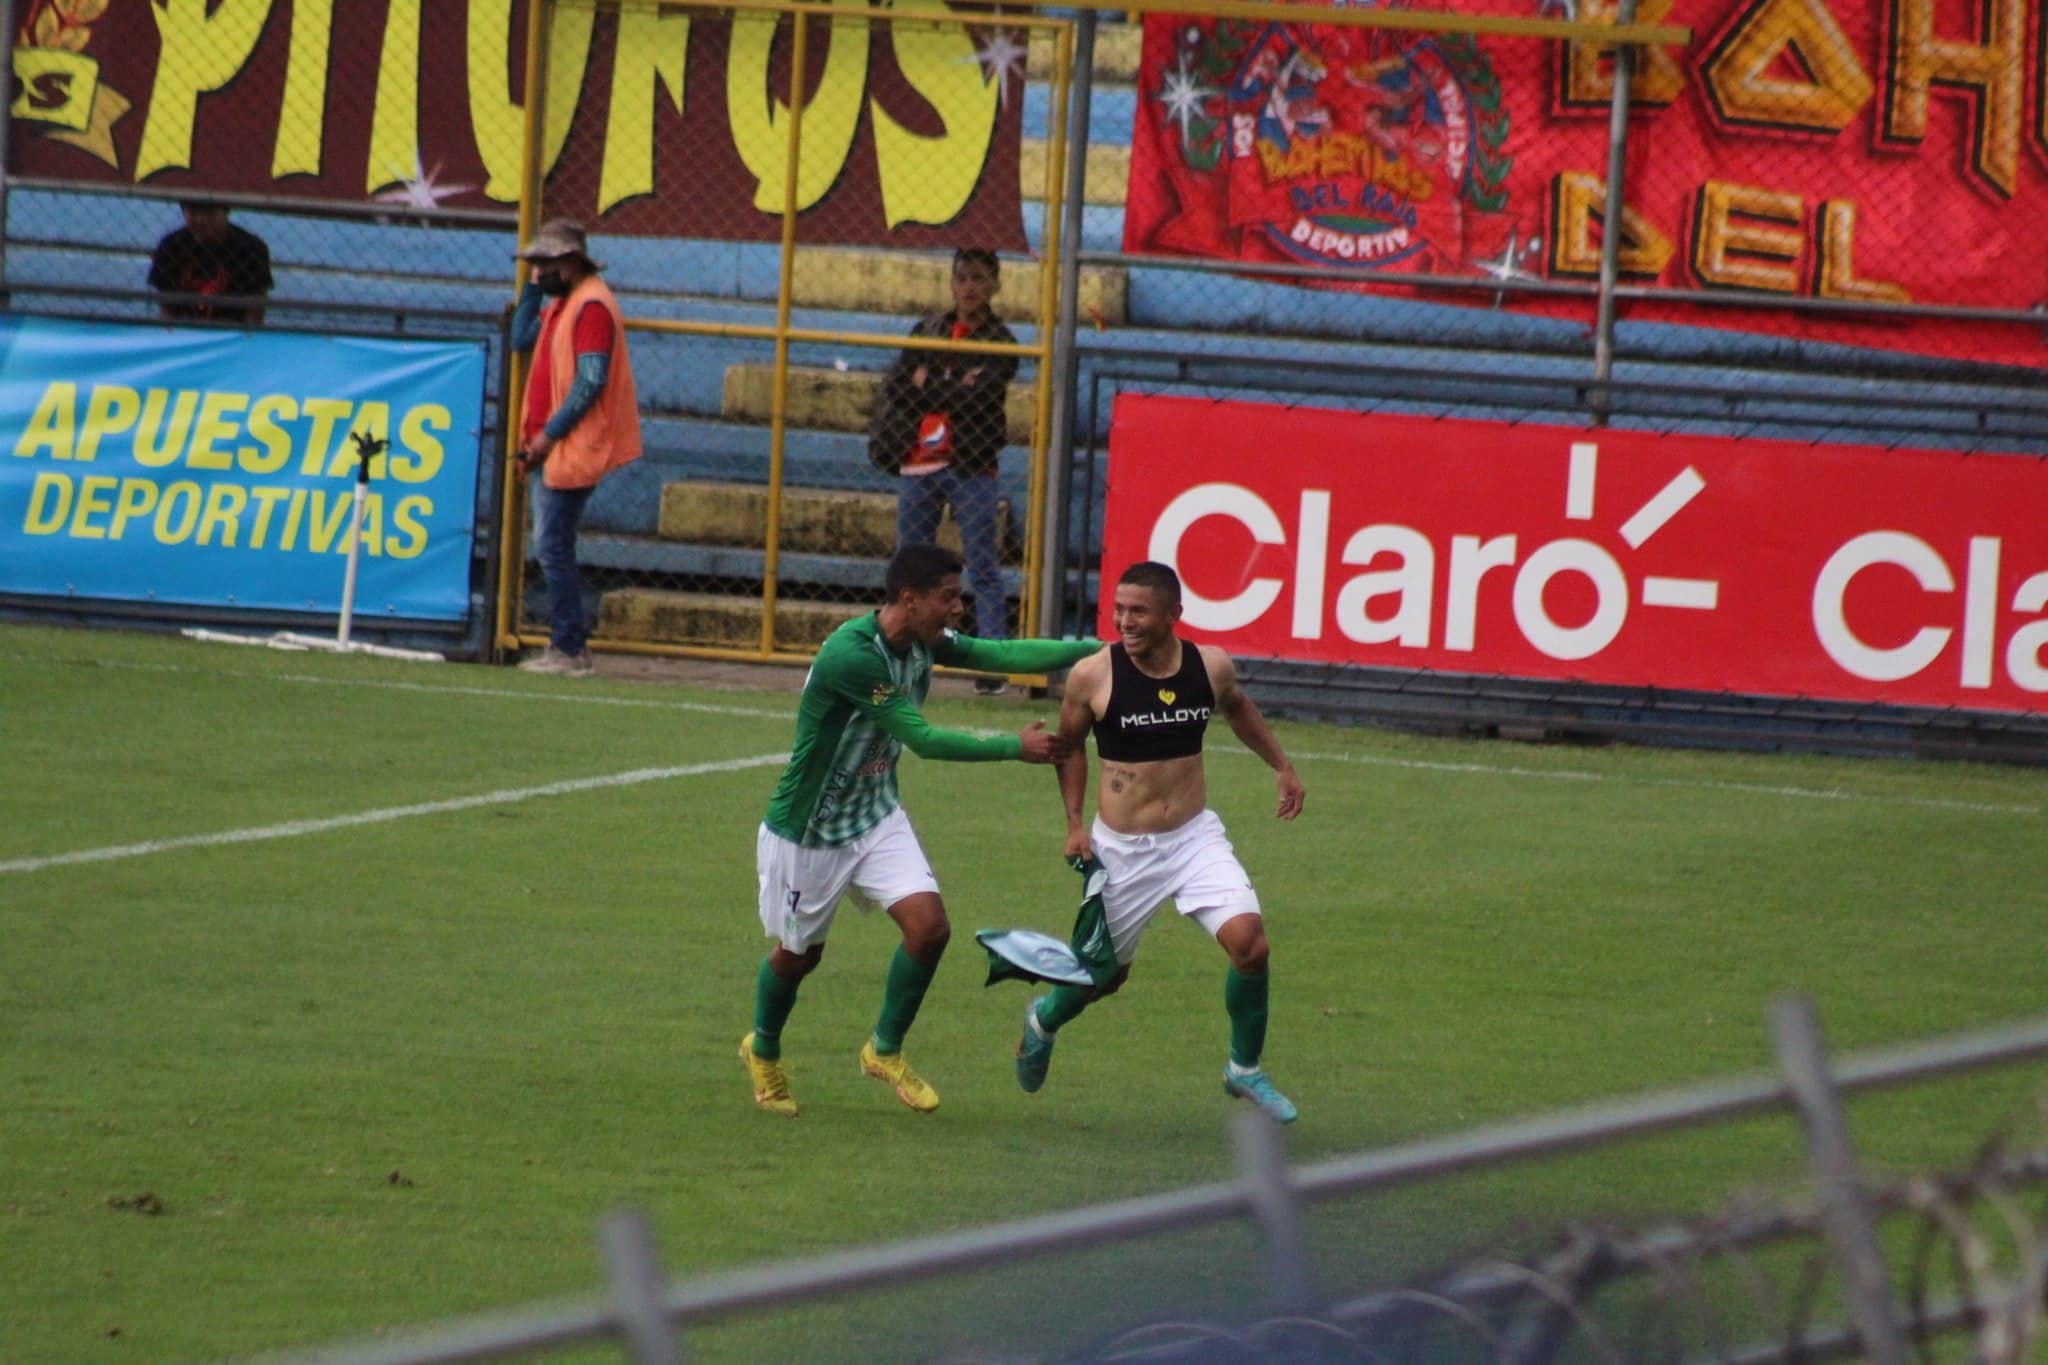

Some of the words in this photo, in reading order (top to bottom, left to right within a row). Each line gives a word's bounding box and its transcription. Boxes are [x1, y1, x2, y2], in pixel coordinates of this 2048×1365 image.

[1551, 171, 1912, 303] DEL
[13, 381, 452, 484] APUESTAS
[23, 471, 435, 560] DEPORTIVAS
[1147, 481, 1629, 661] Claro
